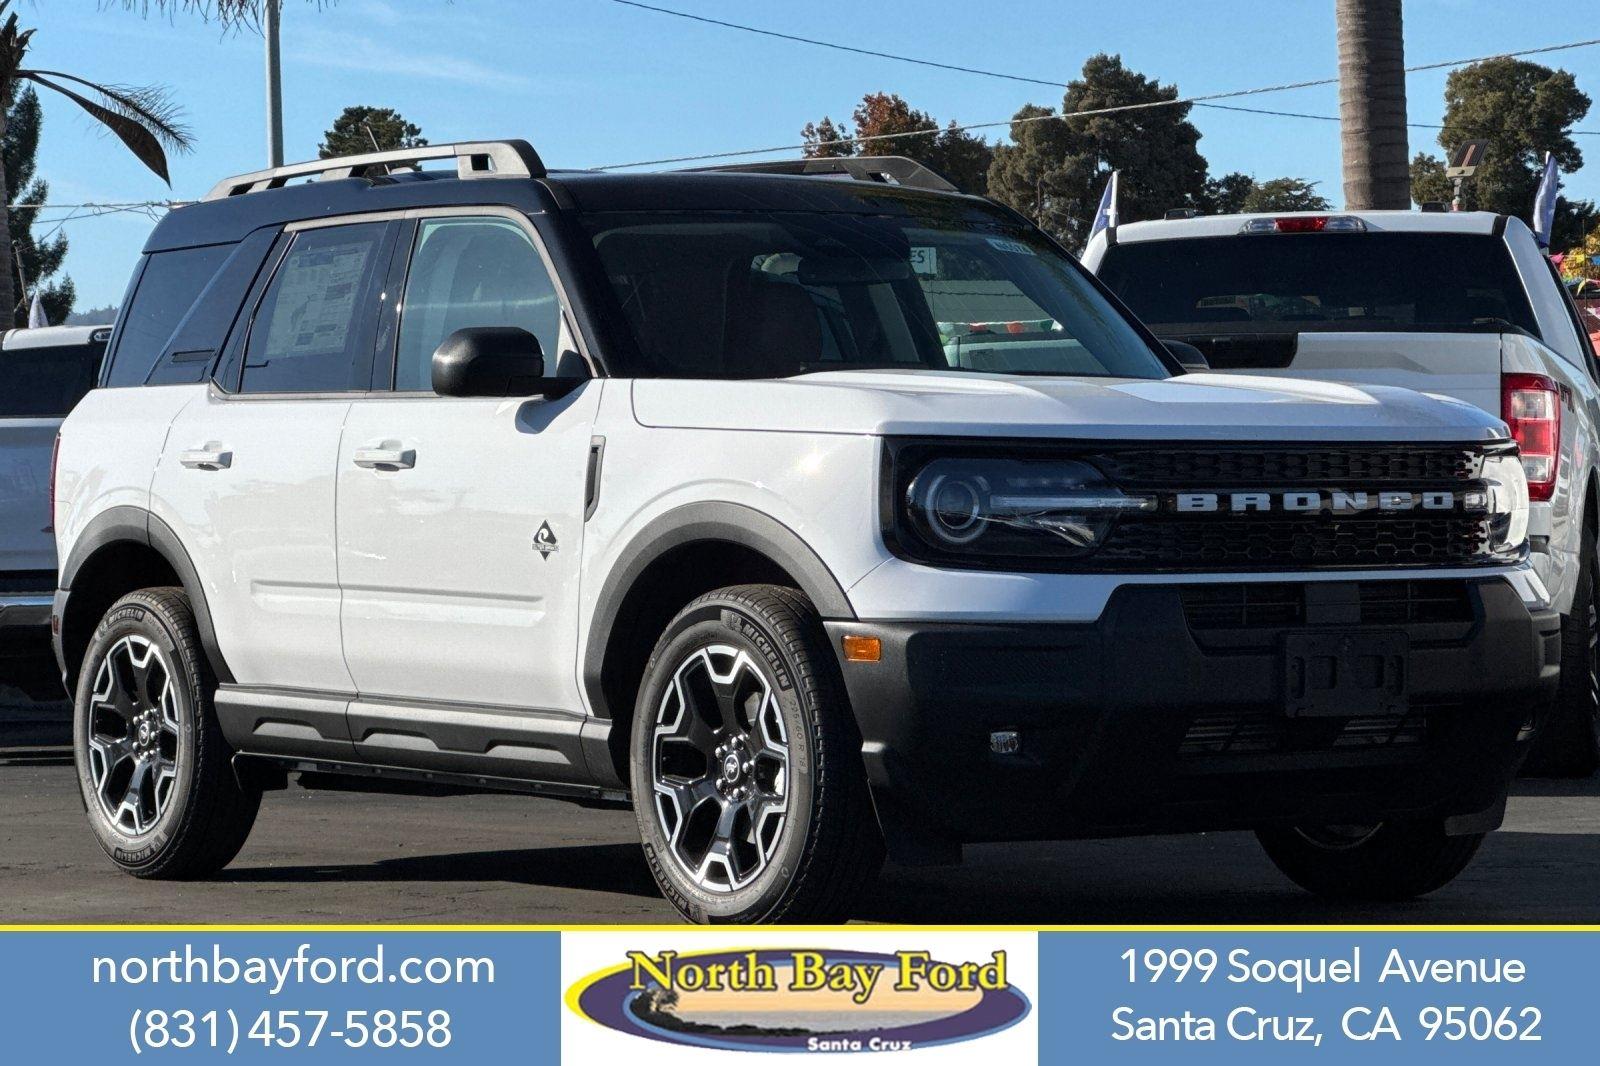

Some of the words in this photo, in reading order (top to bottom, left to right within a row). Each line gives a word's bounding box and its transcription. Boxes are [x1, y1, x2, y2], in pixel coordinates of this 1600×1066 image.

[1176, 492, 1454, 512] BRONCO
[108, 608, 144, 626] MICHELIN
[742, 623, 790, 688] MICHELIN
